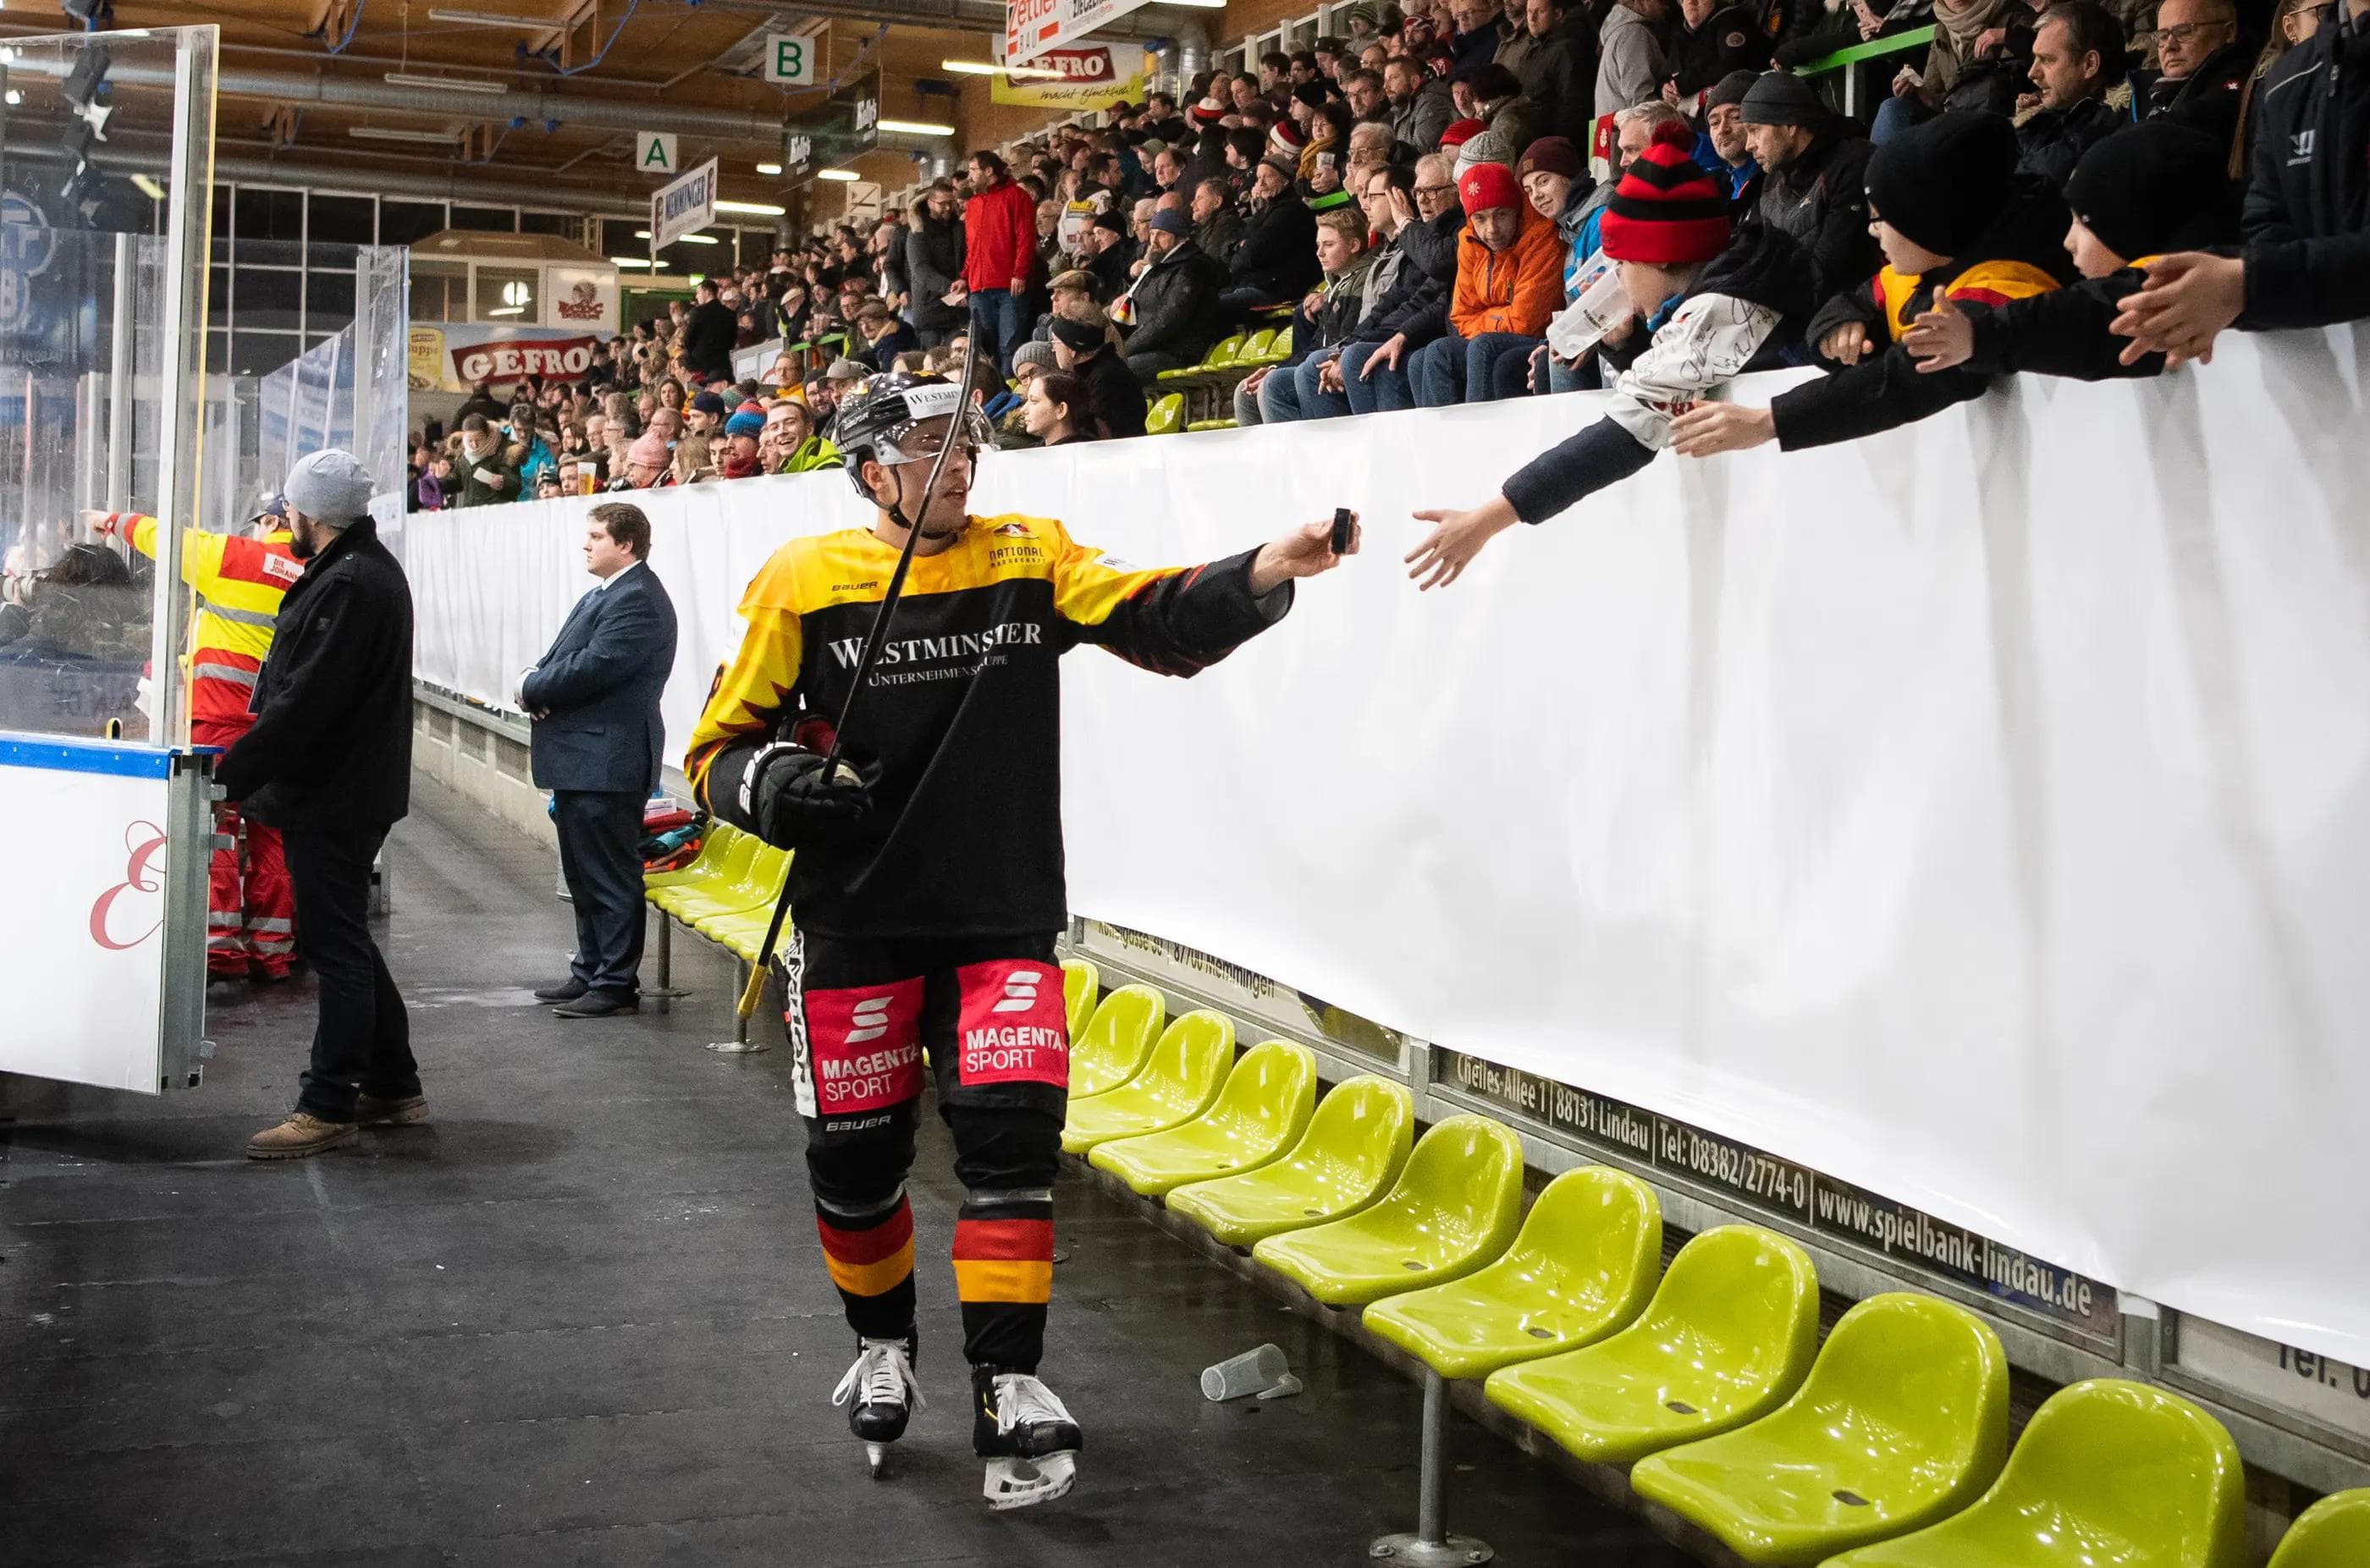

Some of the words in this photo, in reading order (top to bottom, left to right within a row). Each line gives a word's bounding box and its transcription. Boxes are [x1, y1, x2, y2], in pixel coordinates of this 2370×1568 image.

[776, 41, 803, 78] B
[644, 137, 670, 168] A
[462, 346, 592, 381] GEFRO
[989, 547, 1044, 561] NATIONAL
[831, 580, 878, 591] BAUER
[1205, 954, 1275, 999] Memmingen
[966, 1026, 1063, 1053] MAGENTA
[822, 1043, 919, 1081] MAGENTA
[966, 1048, 1035, 1073] SPORT
[825, 1073, 893, 1103] SPORT
[825, 1115, 892, 1132] BAUER
[1556, 1087, 1596, 1132] 88131
[1600, 1098, 1649, 1152] Lindau
[1660, 1123, 1687, 1165] Tel:
[1690, 1134, 1806, 1210] 08382/2774-0
[1818, 1190, 2093, 1318] www.spielbank-lindau.de
